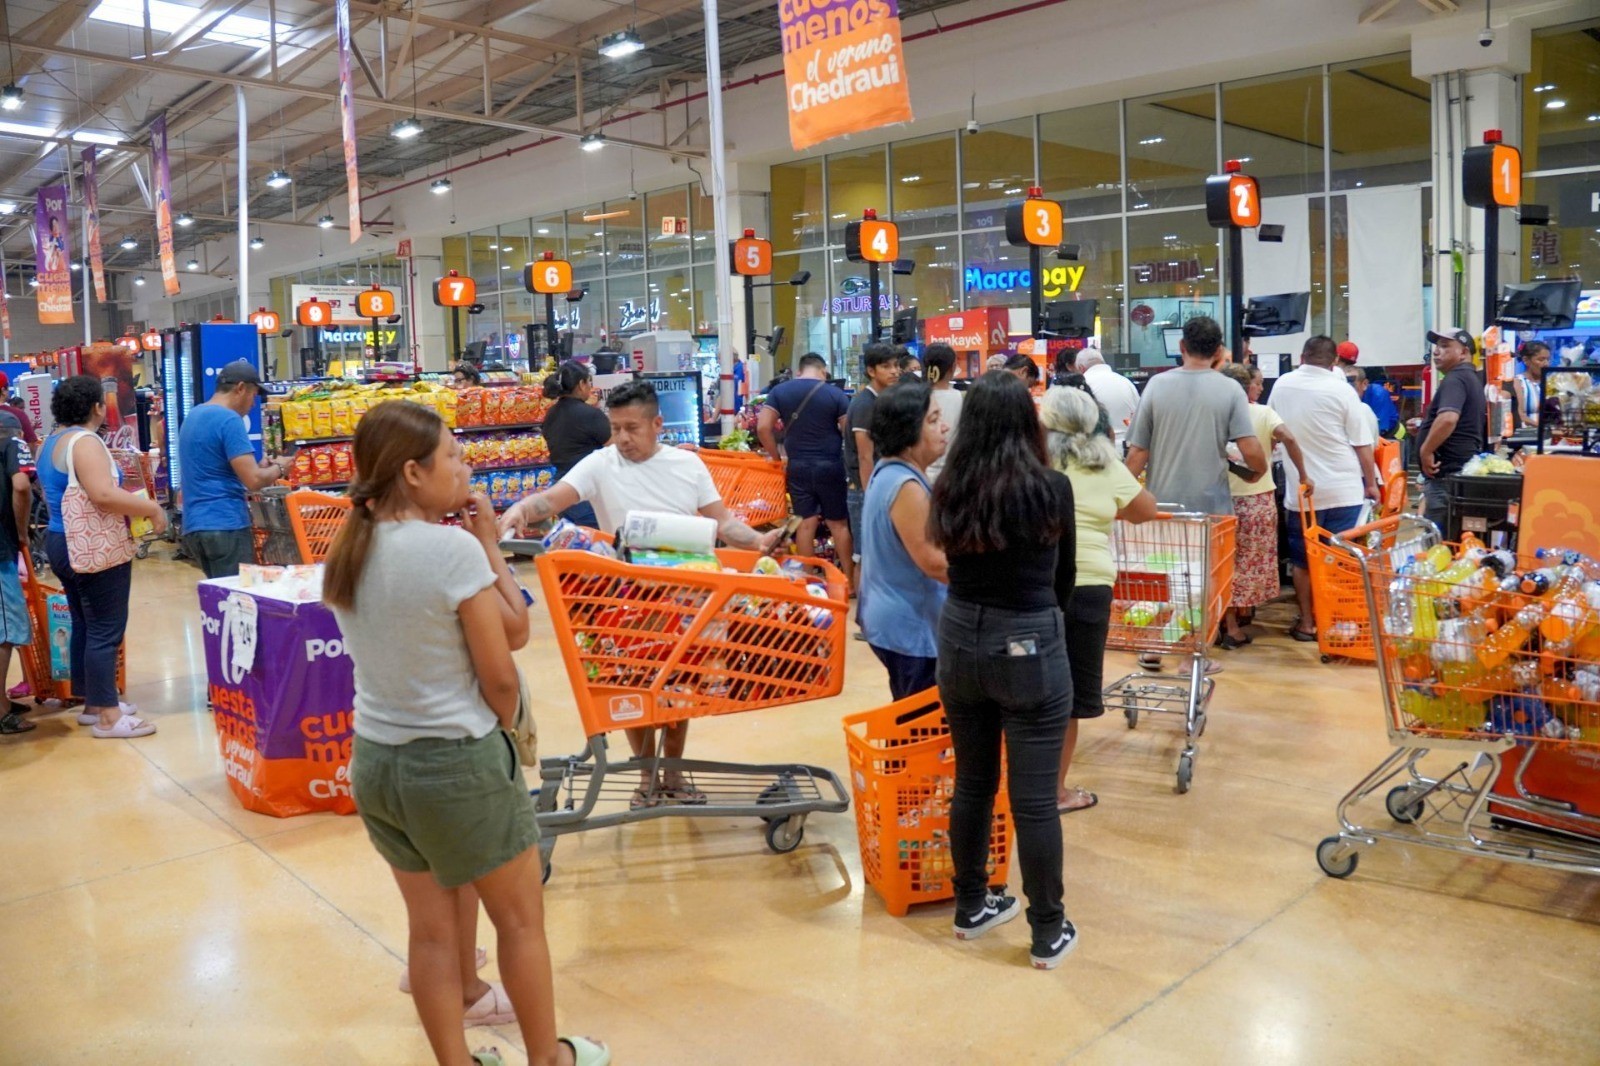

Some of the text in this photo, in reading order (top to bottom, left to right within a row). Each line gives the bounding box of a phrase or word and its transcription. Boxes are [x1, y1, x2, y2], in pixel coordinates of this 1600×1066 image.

[781, 0, 891, 53] menos
[827, 33, 896, 73] verano
[790, 54, 900, 113] Chedraui
[1501, 158, 1510, 194] 1
[1234, 184, 1250, 217] 2
[1036, 209, 1051, 238] 3
[871, 228, 889, 255] 4
[747, 246, 760, 268] 5
[544, 266, 560, 287] 6
[450, 282, 464, 301] 7
[309, 305, 323, 322] 9
[370, 295, 384, 313] 8
[254, 314, 275, 330] 10
[27, 385, 40, 406] Bull
